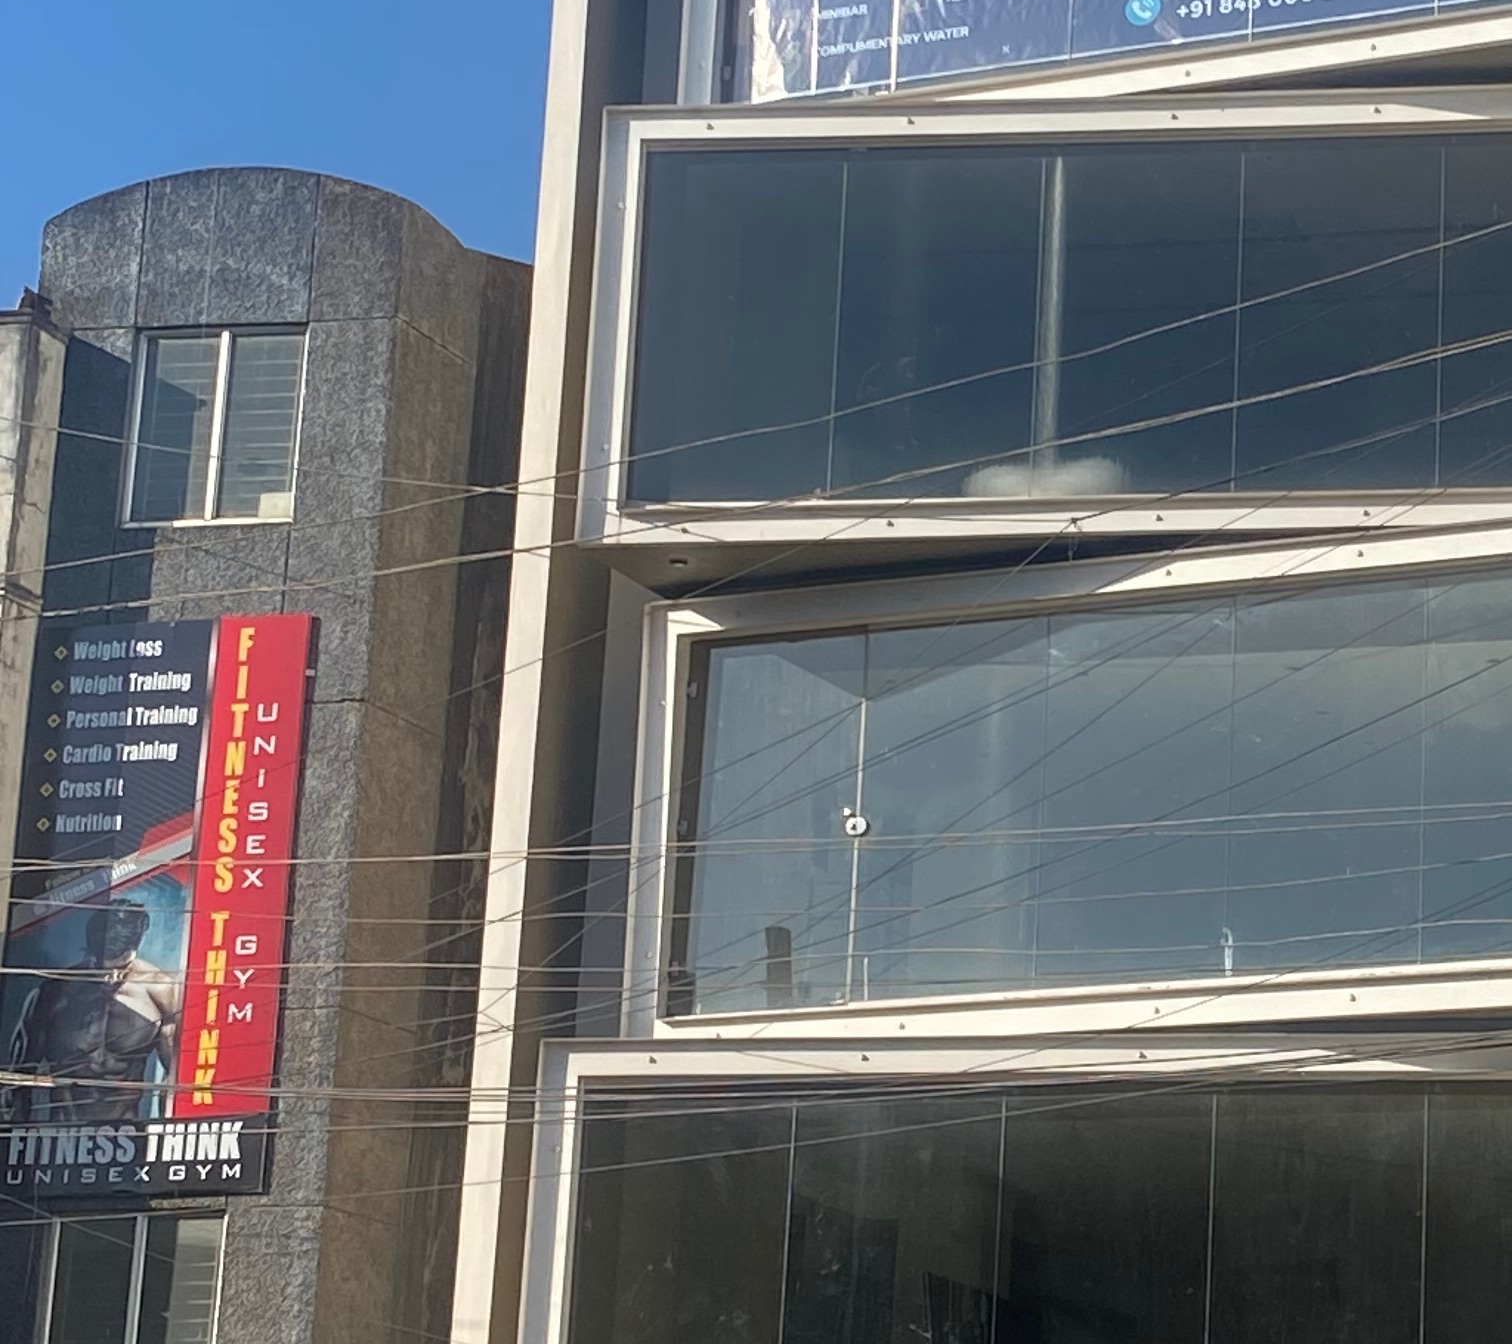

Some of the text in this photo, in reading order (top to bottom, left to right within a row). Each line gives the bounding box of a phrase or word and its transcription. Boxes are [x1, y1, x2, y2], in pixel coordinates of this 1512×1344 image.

[1176, 0, 1213, 18] +91
[924, 25, 970, 43] WATER
[73, 639, 164, 661] Weight Loss
[69, 670, 192, 695] Weight Training
[66, 704, 199, 729] Personal Training
[62, 740, 179, 764] Cardio Training
[58, 777, 125, 799] Cross Fit
[55, 812, 123, 833] Nutrition
[192, 626, 256, 1106] FITNESS THINK
[227, 934, 258, 1024] GYM
[7, 1121, 244, 1165] FITNESS THINK
[6, 1163, 242, 1185] UNISEX GYM
